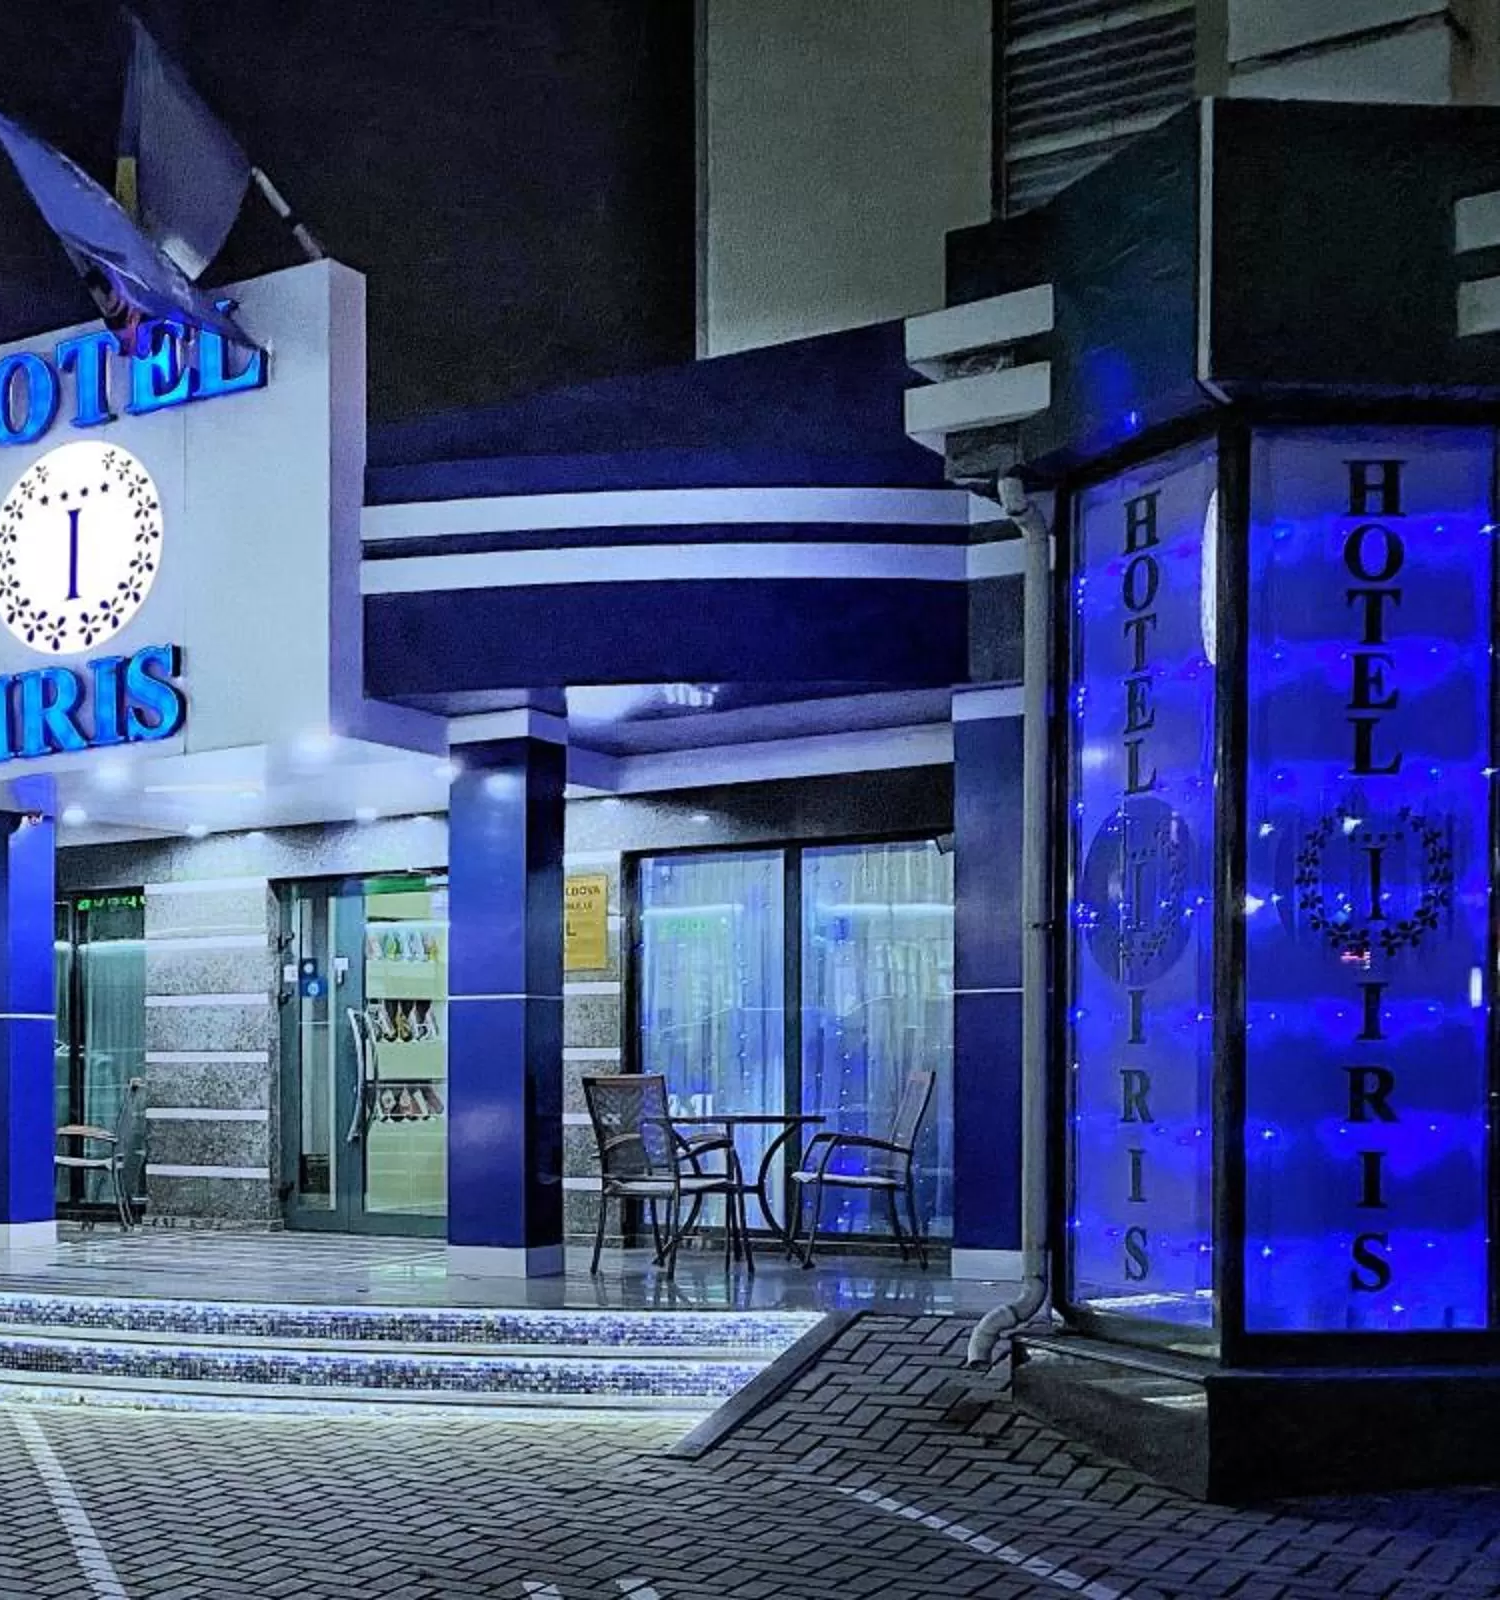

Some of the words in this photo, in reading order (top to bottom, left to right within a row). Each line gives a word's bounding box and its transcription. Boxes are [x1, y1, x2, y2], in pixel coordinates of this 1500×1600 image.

[1122, 489, 1161, 796] HOTEL
[1342, 459, 1407, 776] HOTEL
[1120, 989, 1155, 1282] IRIS
[1342, 981, 1398, 1293] IRIS
